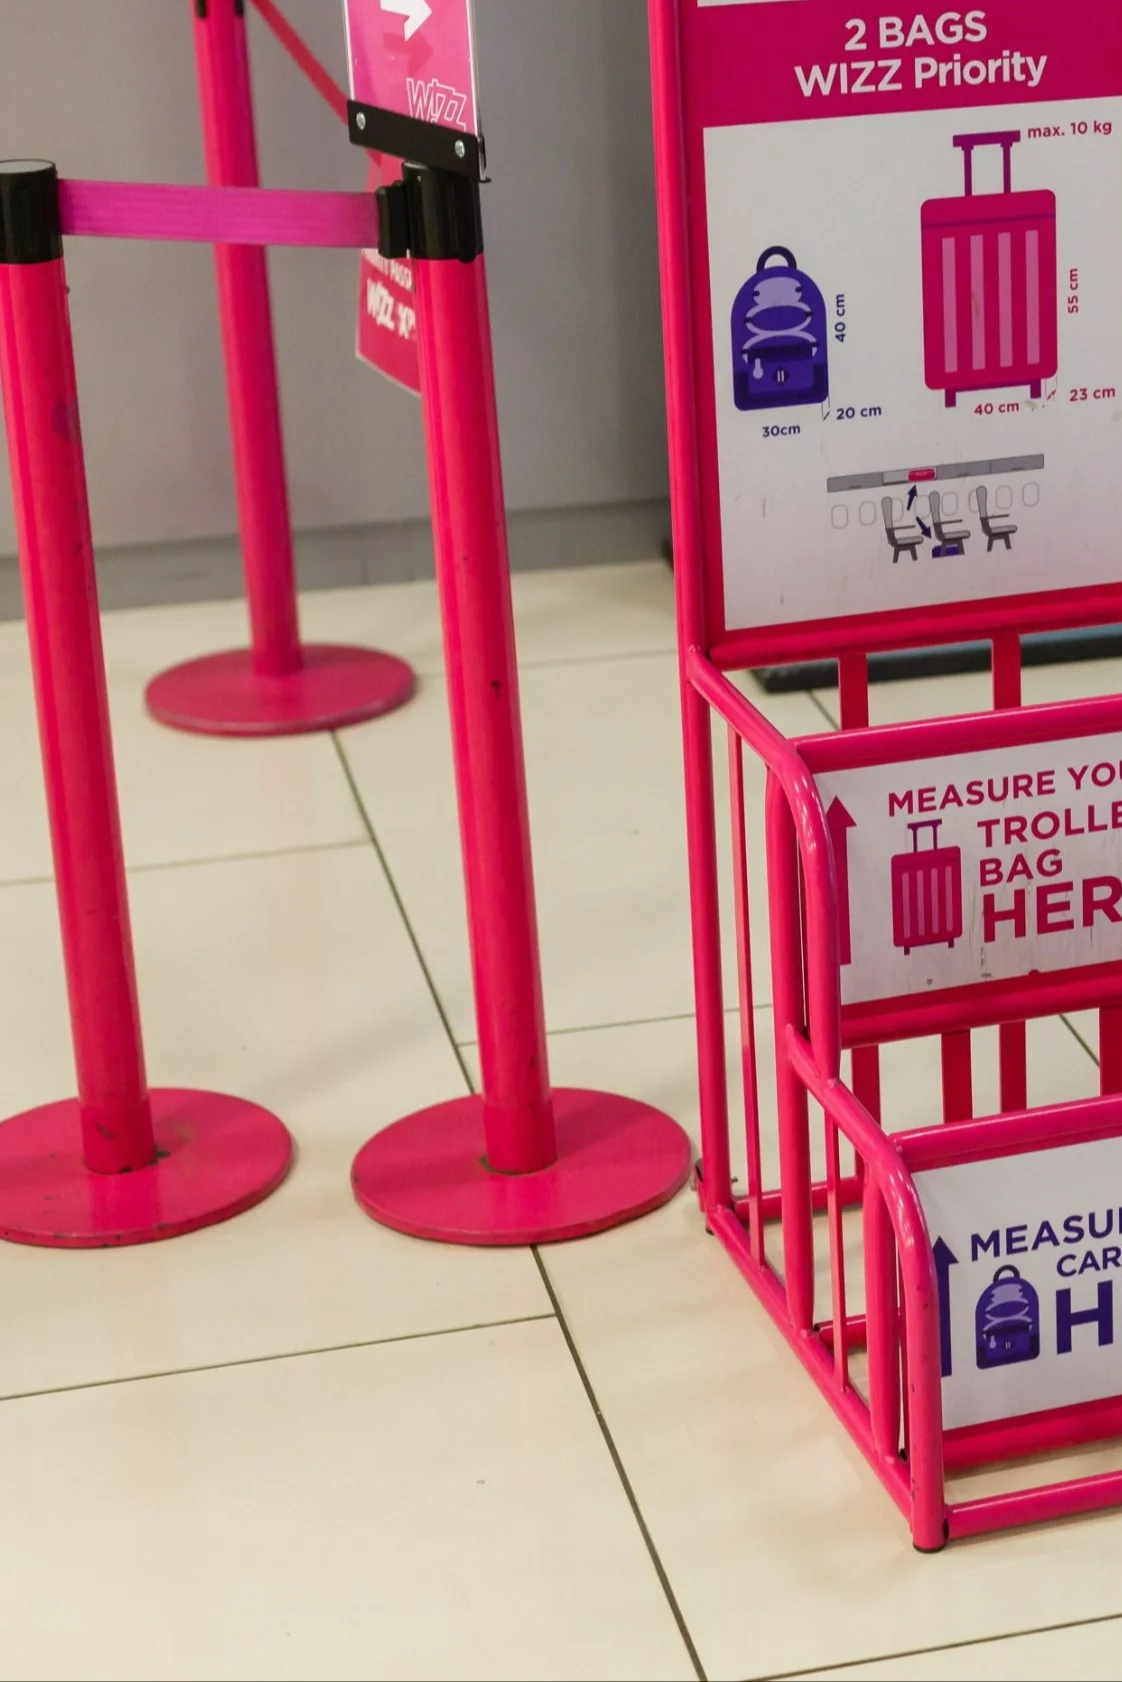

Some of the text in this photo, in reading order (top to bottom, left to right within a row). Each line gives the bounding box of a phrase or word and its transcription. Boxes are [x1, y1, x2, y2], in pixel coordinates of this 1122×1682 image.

[844, 10, 988, 51] 2 BAGS
[794, 49, 1048, 97] WIZZ Priority
[1027, 120, 1112, 139] max. 10 kg
[1067, 268, 1079, 315] 55 cm
[834, 293, 846, 343] 40 cm
[836, 406, 882, 421] 20 cm
[974, 402, 1020, 416] 40 cm
[1069, 387, 1116, 402] 23 cm
[762, 424, 801, 438] 30cm
[888, 770, 1056, 817] MEASURE
[979, 849, 1063, 887] BAG
